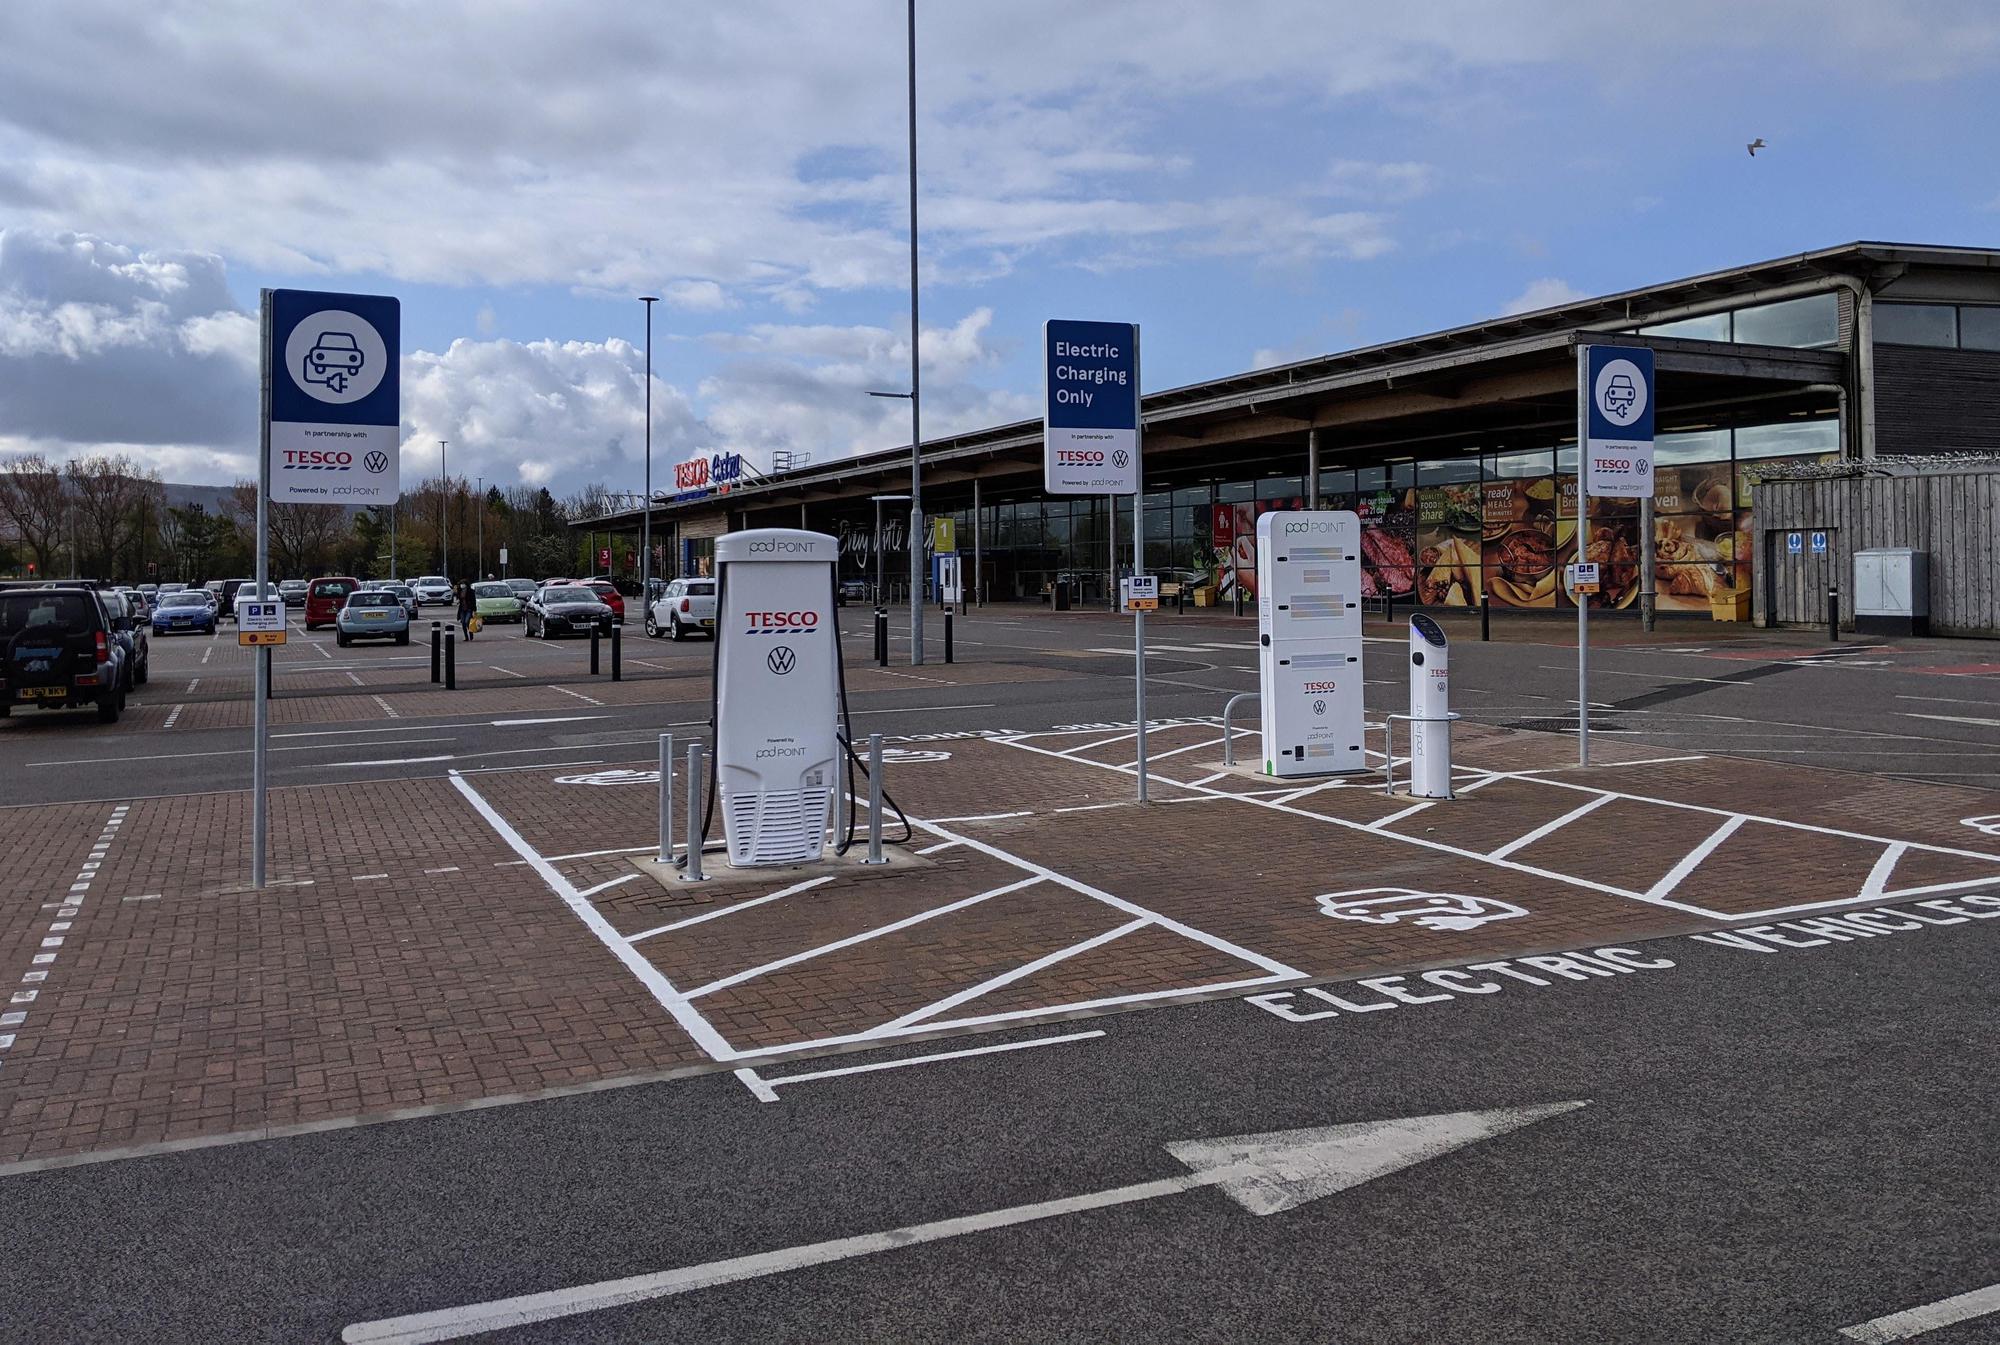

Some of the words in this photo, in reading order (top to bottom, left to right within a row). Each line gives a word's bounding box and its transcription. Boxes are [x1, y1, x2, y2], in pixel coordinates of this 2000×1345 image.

[1056, 342, 1119, 358] Electric
[1056, 366, 1127, 385] Charging
[1057, 389, 1093, 407] Only
[312, 431, 352, 439] partnership
[283, 450, 352, 464] TESCO
[1057, 450, 1104, 462] TESCO
[673, 458, 708, 488] TESCO
[712, 452, 741, 484] extra
[1594, 459, 1630, 469] TESCO
[289, 486, 318, 494] Powered
[319, 487, 328, 495] by
[1487, 485, 1512, 500] ready
[1420, 493, 1443, 501] QUALITY
[1654, 495, 1678, 507] ven
[1421, 501, 1437, 509] FOOD
[1487, 500, 1512, 509] MEALS
[1421, 509, 1444, 520] share
[939, 522, 947, 538] 1
[601, 550, 609, 559] 3
[745, 611, 818, 627] TESCO
[1303, 681, 1335, 691] TESCO
[1244, 947, 1676, 1022] ELECTRIC
